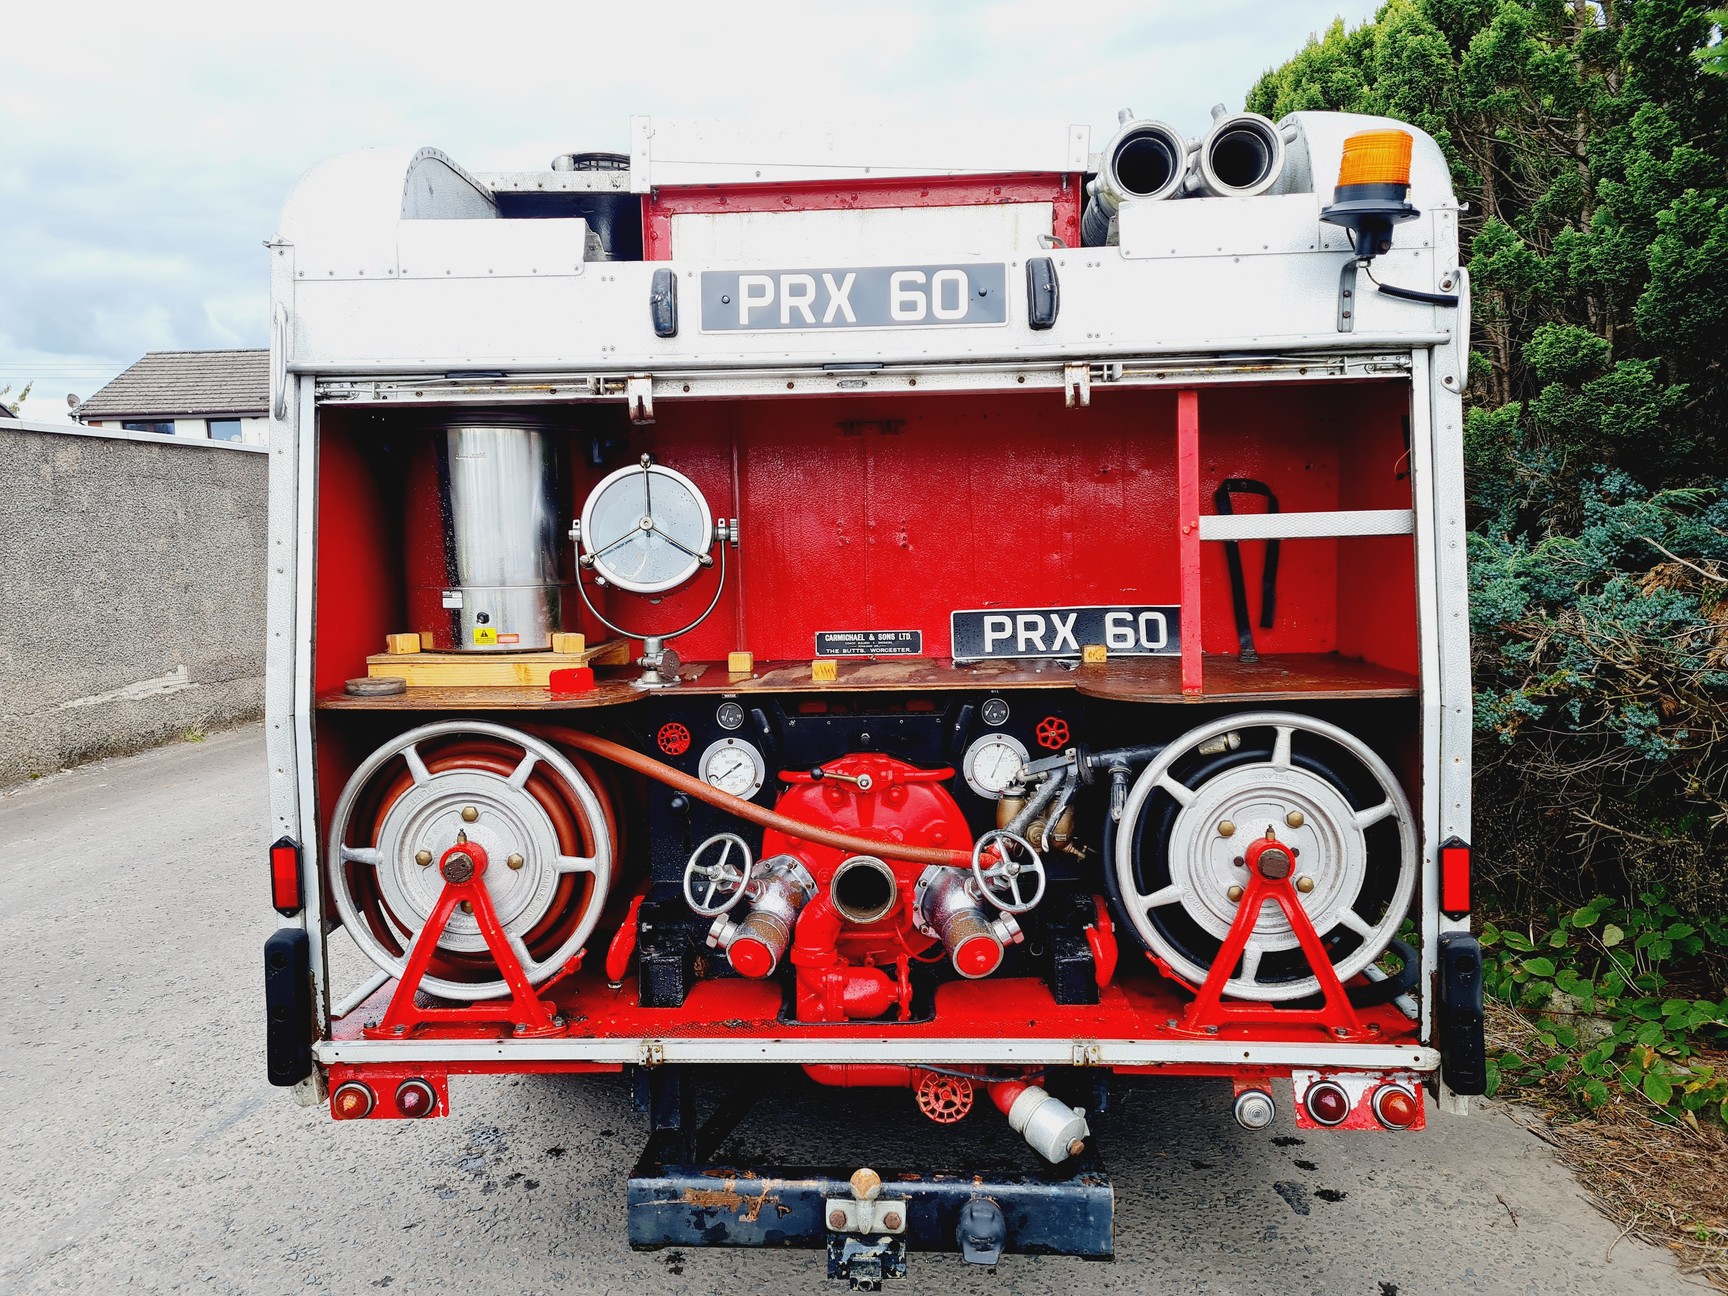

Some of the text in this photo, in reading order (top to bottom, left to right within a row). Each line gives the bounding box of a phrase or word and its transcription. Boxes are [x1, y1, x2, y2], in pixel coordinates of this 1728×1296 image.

[739, 269, 968, 325] PRX 60
[825, 634, 865, 642] CARMICHAEL
[984, 611, 1168, 653] PRX 60
